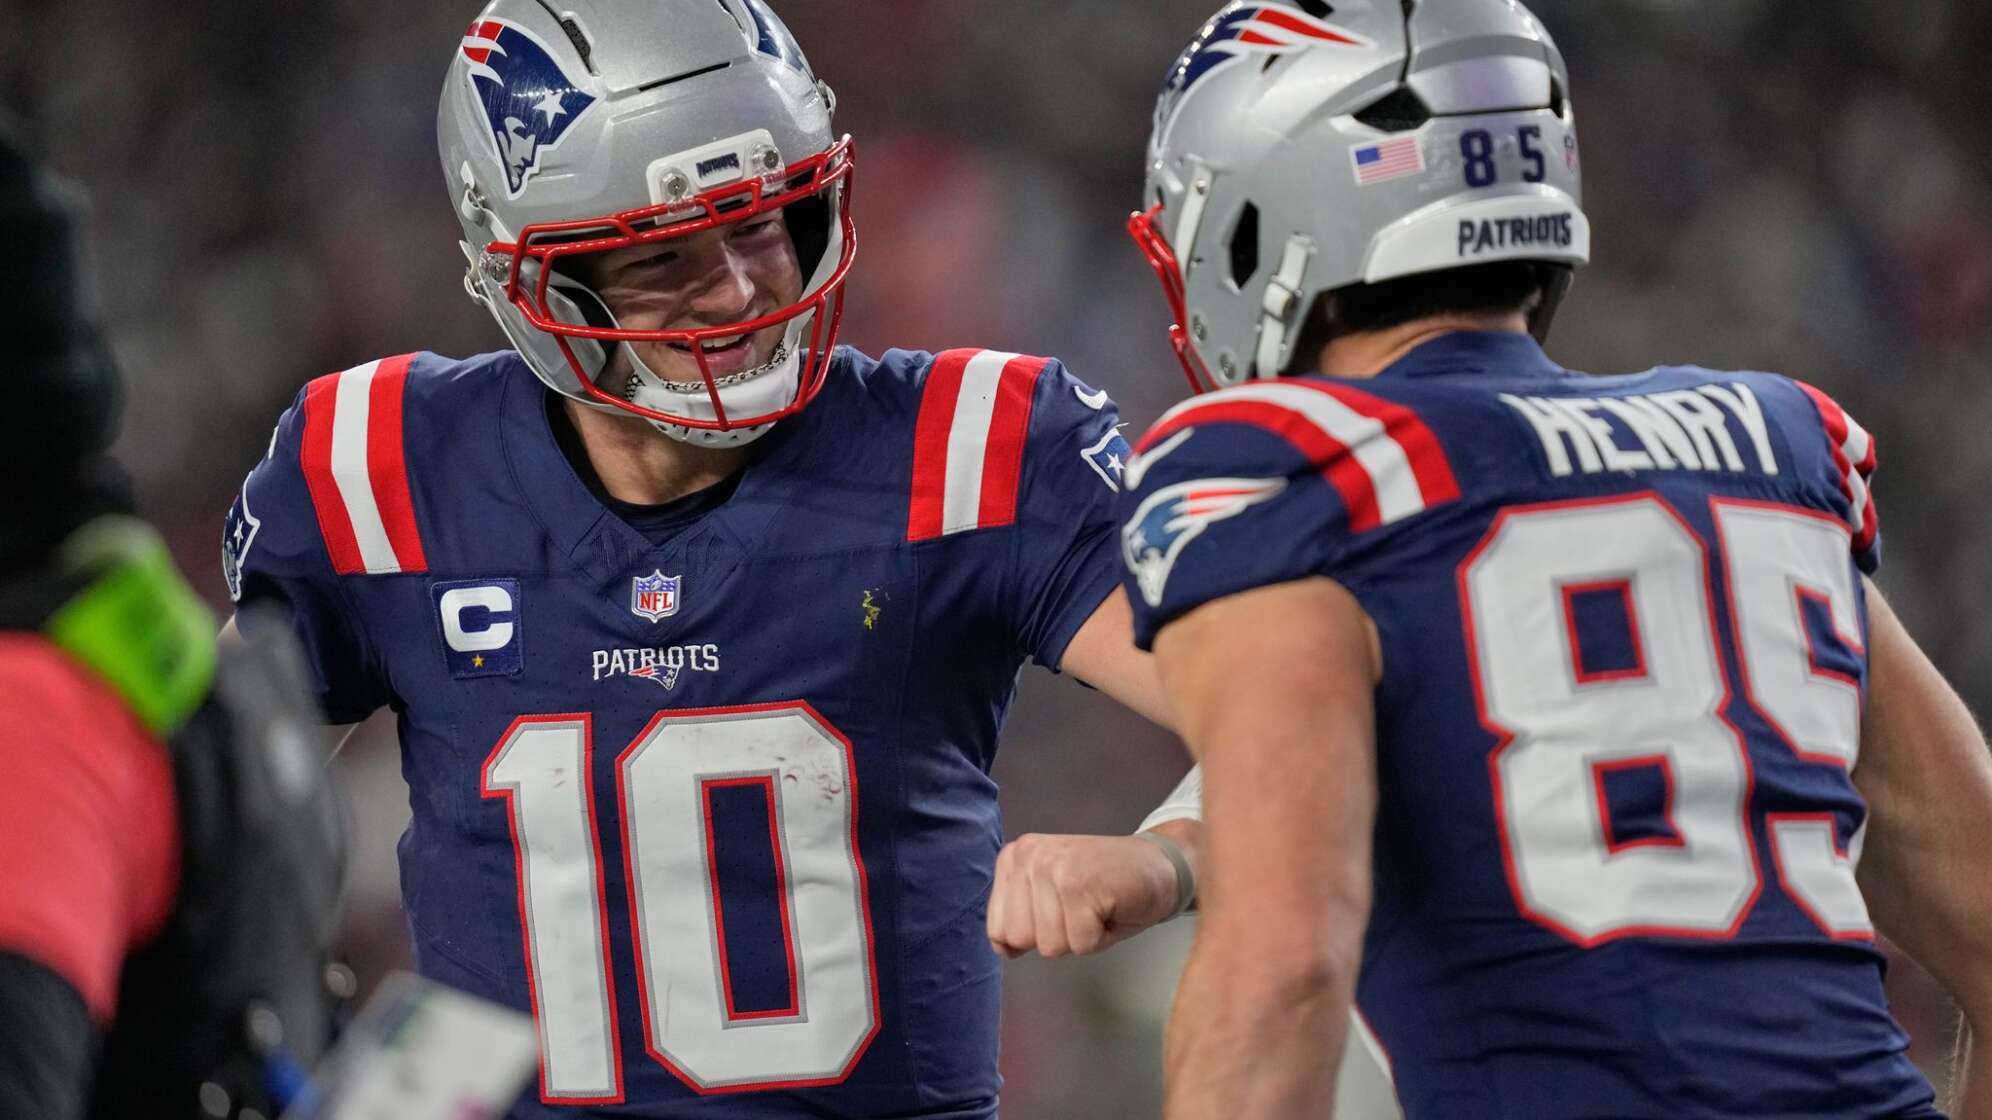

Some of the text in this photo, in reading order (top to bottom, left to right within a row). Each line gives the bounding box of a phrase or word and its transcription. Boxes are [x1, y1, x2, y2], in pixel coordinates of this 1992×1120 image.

[1459, 126, 1546, 188] 85
[1458, 212, 1572, 256] PATRIOTS
[1499, 382, 1778, 476] HENRY
[439, 586, 513, 652] C
[640, 591, 673, 611] NFL
[592, 644, 720, 681] PATRIOTS
[1456, 490, 1875, 948] 85
[480, 699, 882, 1105] 10
